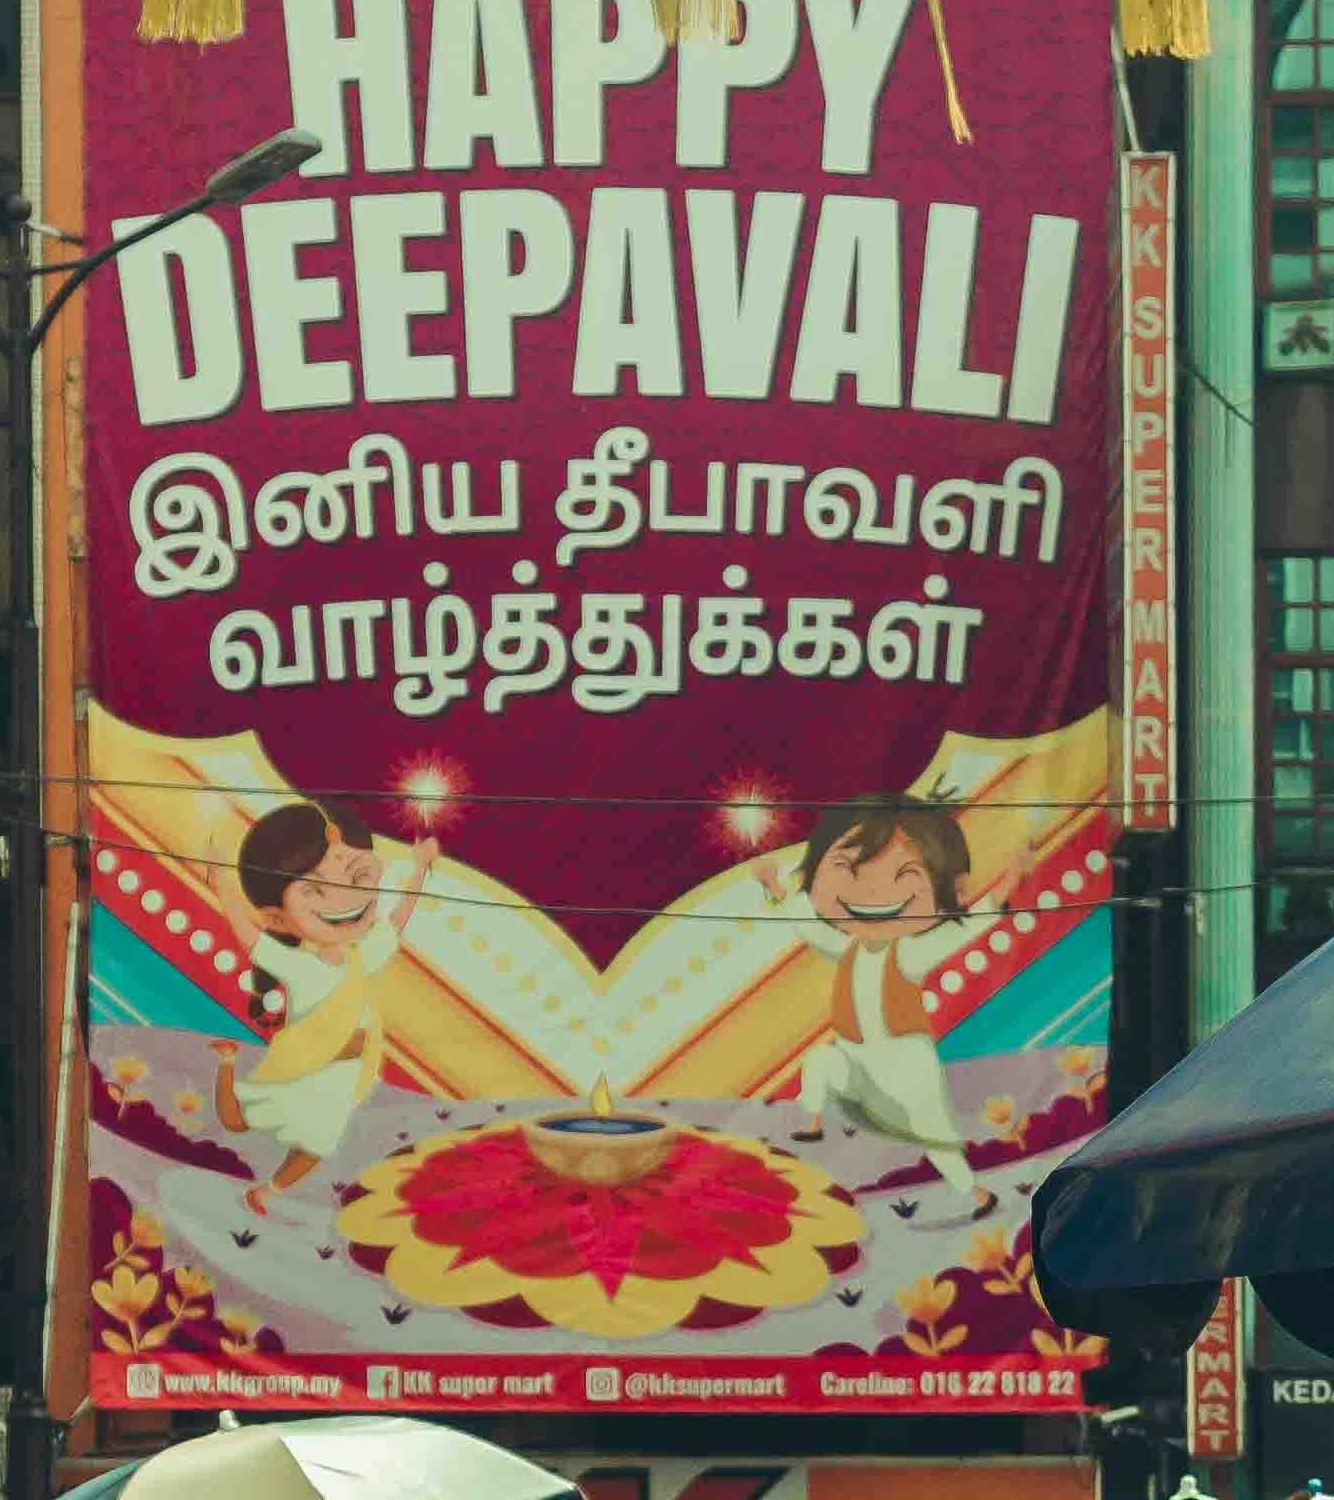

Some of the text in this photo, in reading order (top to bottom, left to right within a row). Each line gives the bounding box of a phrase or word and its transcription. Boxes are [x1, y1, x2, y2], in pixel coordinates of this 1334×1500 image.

[112, 184, 1079, 426] DEEPAVALI
[1131, 296, 1165, 573] SUPER
[128, 425, 1064, 599] இனிய தீபாவளி
[207, 561, 983, 718] வாழ்த்துக்கள்
[1131, 602, 1167, 816] MART
[164, 1370, 342, 1400] www.kkgroup.my
[439, 1373, 499, 1398] super
[503, 1371, 556, 1396] mart
[624, 1371, 788, 1400] @kksupermart
[968, 1370, 996, 1396] 22
[1048, 1370, 1077, 1396] 22
[1197, 1351, 1231, 1451] MART
